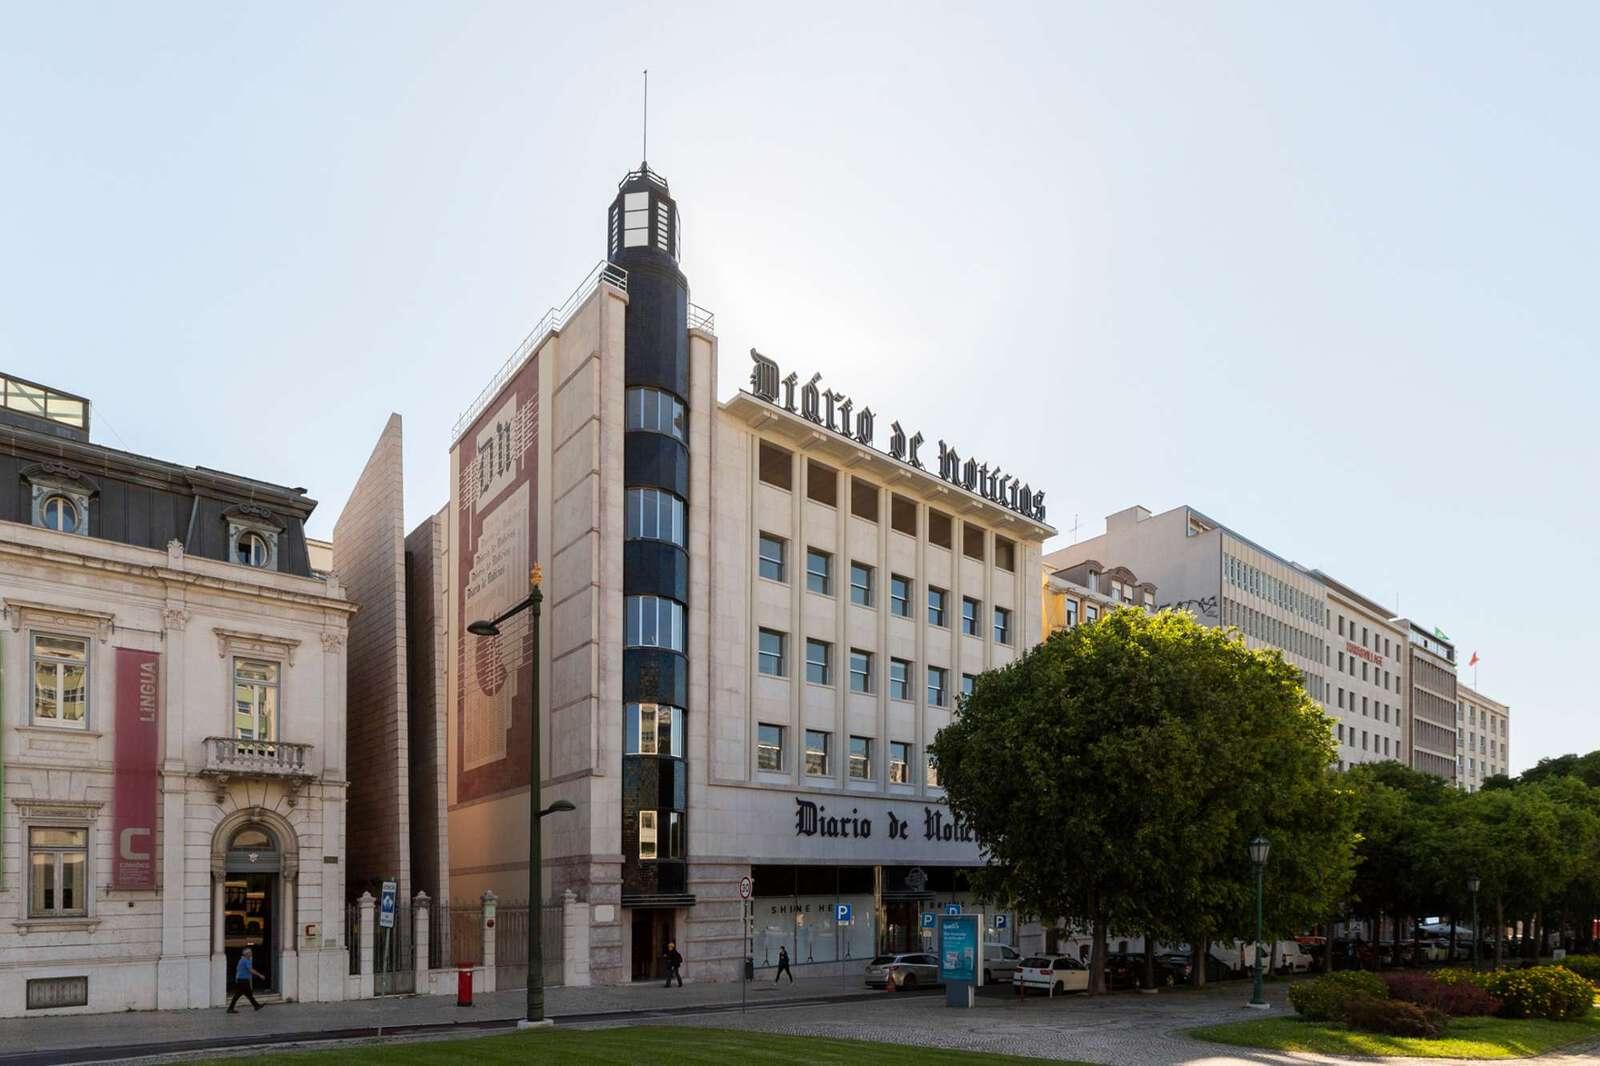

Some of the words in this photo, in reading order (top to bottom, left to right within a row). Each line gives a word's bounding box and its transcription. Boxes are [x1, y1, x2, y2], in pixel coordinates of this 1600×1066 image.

[750, 348, 876, 444] Diário
[889, 420, 924, 470] de
[938, 439, 1046, 522] Notícias
[796, 797, 871, 839] Diario
[888, 811, 909, 840] de
[120, 828, 151, 860] C
[771, 904, 811, 914] SHINE
[838, 905, 848, 919] P
[924, 915, 933, 926] P
[996, 916, 1005, 928] P
